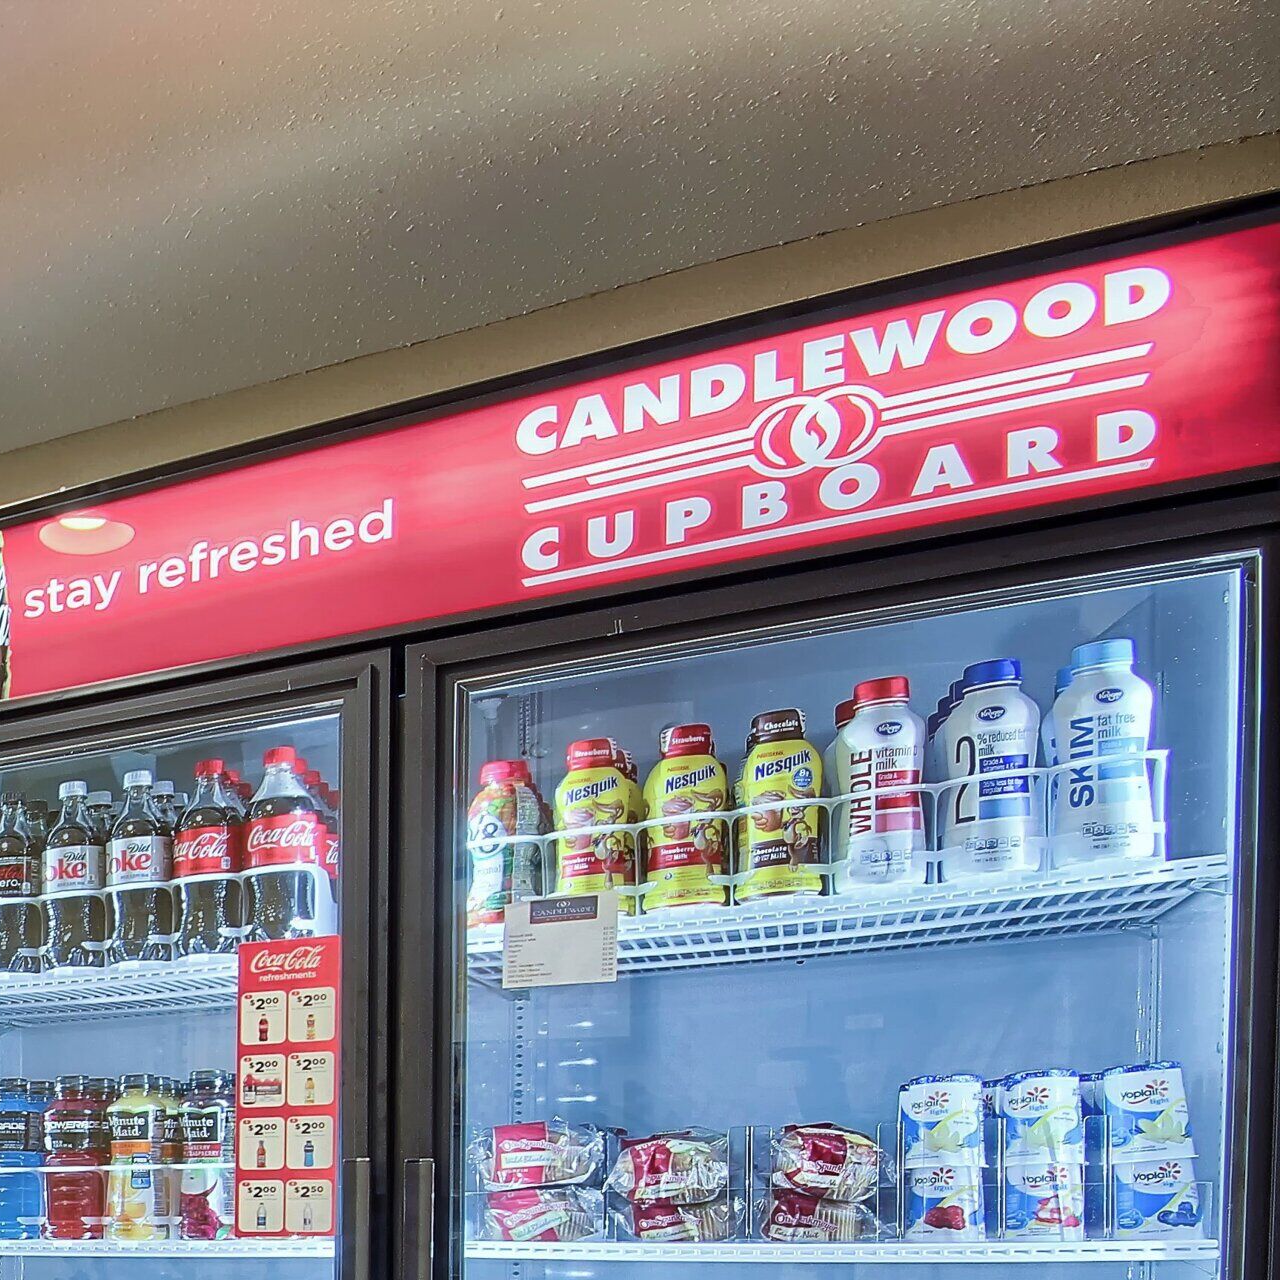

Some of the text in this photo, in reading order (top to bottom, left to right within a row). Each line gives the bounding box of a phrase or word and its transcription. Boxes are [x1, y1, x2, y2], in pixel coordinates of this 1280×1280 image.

[514, 265, 1172, 456] CANDLEWOOD
[520, 408, 1158, 573] CUPBOARD
[23, 498, 394, 619] stay refreshed
[1098, 690, 1123, 702] Kroger
[980, 707, 1005, 719] Kroger
[1097, 712, 1136, 727] fat free
[764, 718, 799, 731] Chocolate
[878, 722, 903, 735] Kroger
[977, 733, 988, 745] %
[988, 729, 1017, 743] reduced
[1097, 726, 1122, 739] milk
[575, 748, 610, 758] Strawberry
[875, 745, 911, 759] vitamin
[978, 744, 996, 757] milk
[754, 750, 812, 781] Nesquik
[875, 758, 898, 771] milk
[1069, 715, 1094, 809] SKIM
[664, 763, 717, 794] Nesquik
[565, 776, 620, 807] Nesquik
[850, 748, 872, 837] WHOLE
[246, 820, 317, 852] Coca-Cola
[127, 843, 151, 854] Diet
[63, 851, 87, 862] Diet
[43, 858, 87, 882] oke
[249, 945, 326, 973] Coca-Cola
[259, 970, 317, 983] refreshments
[1119, 1086, 1159, 1102] yoplait
[108, 1115, 146, 1127] Minute
[1132, 1168, 1172, 1184] yoplait
